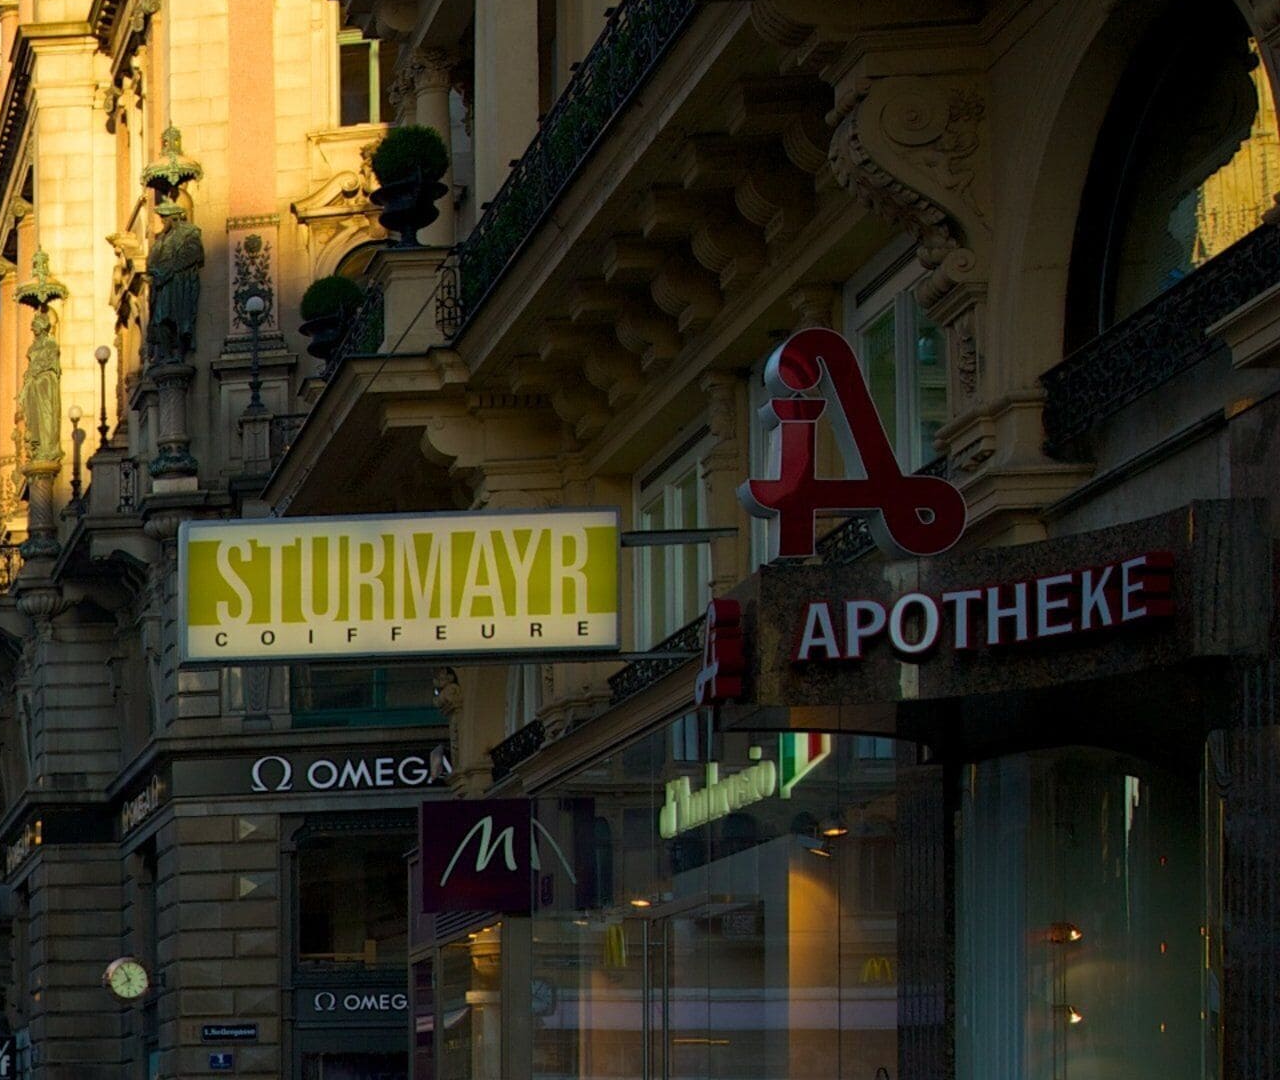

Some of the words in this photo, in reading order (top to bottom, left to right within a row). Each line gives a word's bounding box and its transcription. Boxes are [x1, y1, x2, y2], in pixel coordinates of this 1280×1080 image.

[215, 528, 589, 626] STURMAYR
[215, 621, 589, 647] COIFFEURE
[796, 556, 1150, 661] APOTHEKE
[343, 993, 408, 1011] OMEG
